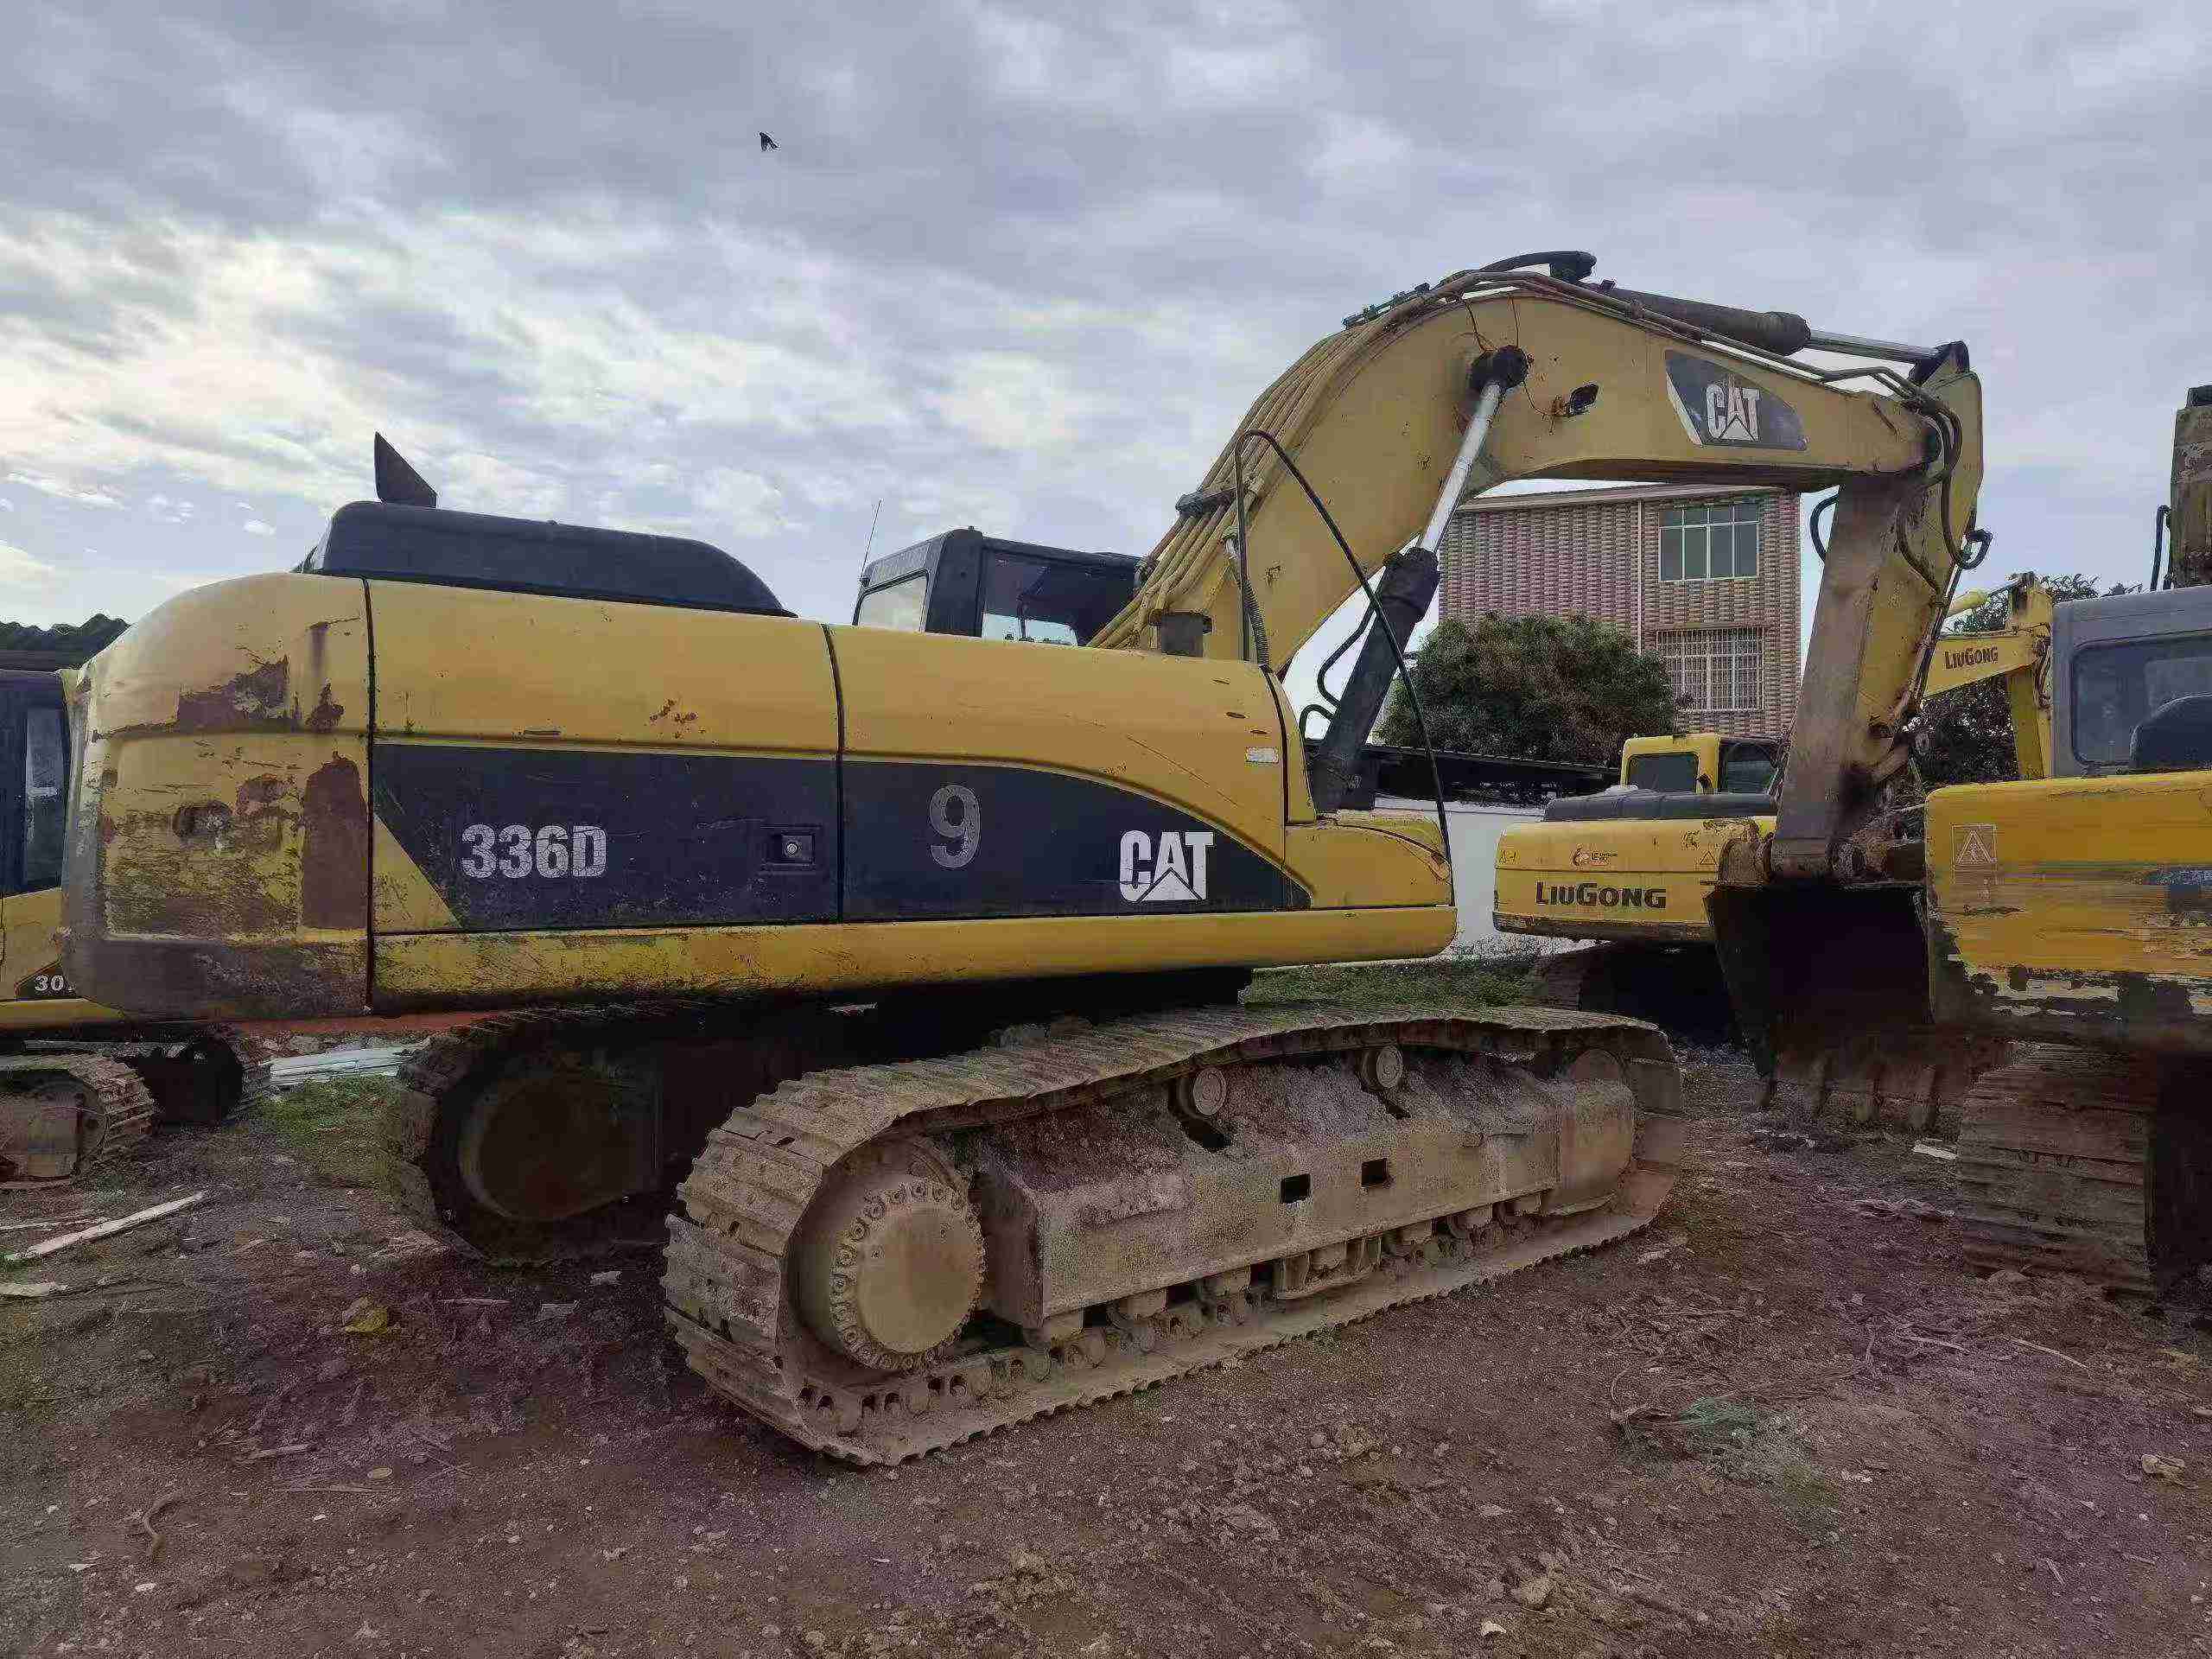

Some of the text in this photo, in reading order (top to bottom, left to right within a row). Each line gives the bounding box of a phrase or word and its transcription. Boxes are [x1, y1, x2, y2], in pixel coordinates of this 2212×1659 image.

[1706, 383, 1760, 442] CAT
[461, 823, 607, 879] 336D
[929, 785, 981, 868] 9
[1119, 830, 1214, 903] CAT
[35, 974, 75, 991] 30
